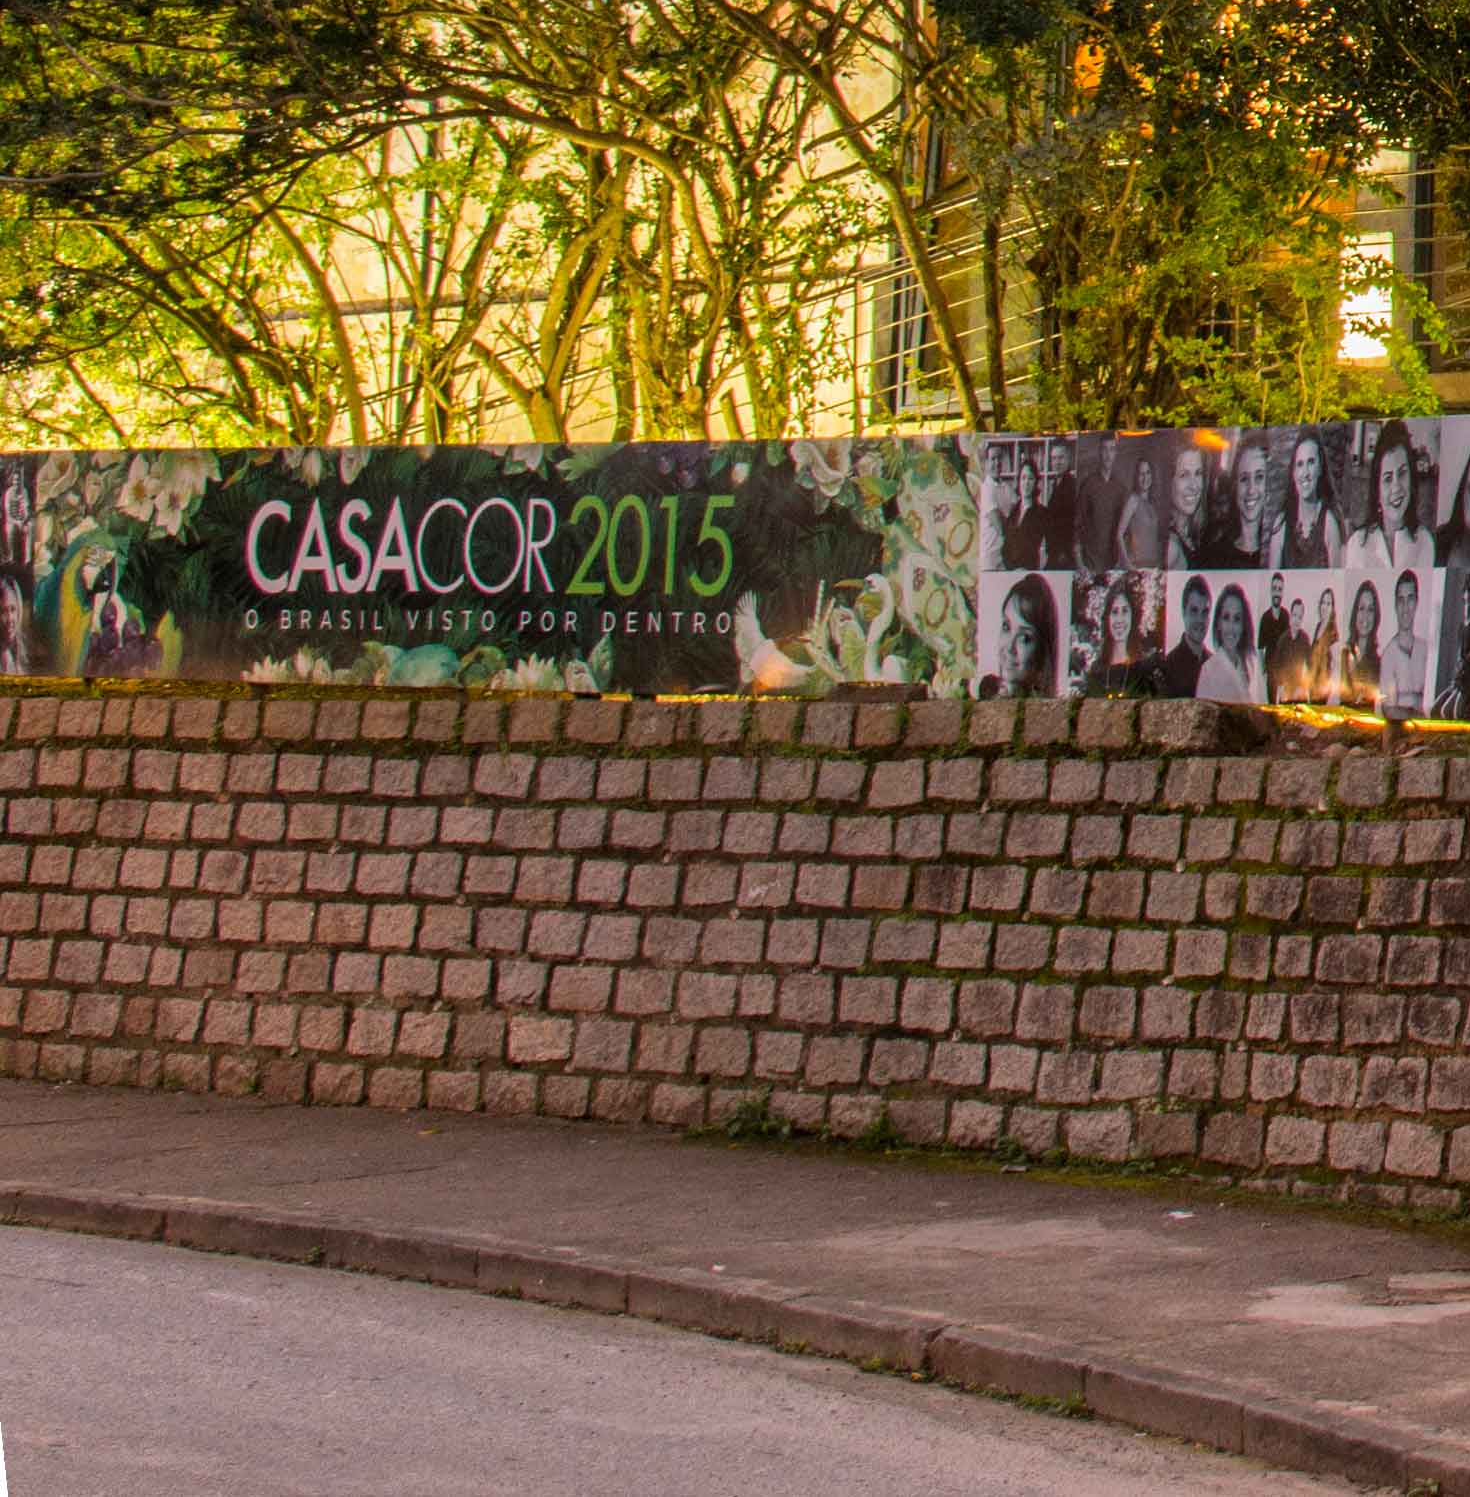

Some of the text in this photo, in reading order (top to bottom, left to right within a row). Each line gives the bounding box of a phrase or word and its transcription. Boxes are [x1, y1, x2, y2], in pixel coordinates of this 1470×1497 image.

[244, 493, 736, 597] CASACOR 2015
[244, 608, 732, 635] O BRASIL VISTO POR DENTRO
